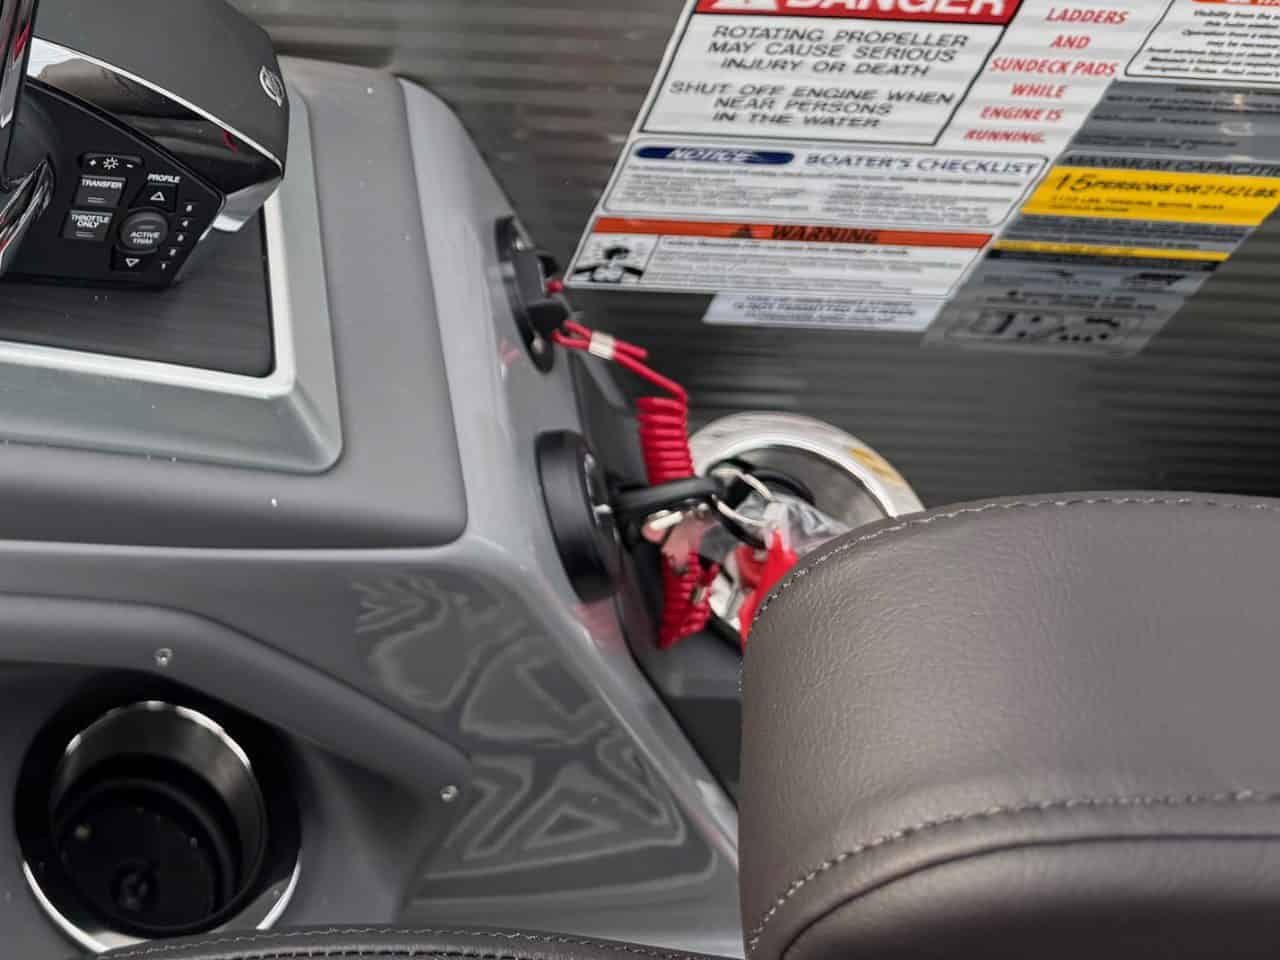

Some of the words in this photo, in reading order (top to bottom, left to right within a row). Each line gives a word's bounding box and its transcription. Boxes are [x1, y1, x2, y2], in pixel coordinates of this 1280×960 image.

[1045, 8, 1129, 25] LADDERS
[712, 25, 825, 42] ROTATING
[833, 29, 969, 48] PROPELLER
[1050, 35, 1091, 49] AND
[708, 42, 755, 54] MAY
[765, 42, 844, 58] CAUSE
[853, 46, 958, 62] SERIOUS
[720, 58, 802, 72] INJURY
[811, 60, 846, 73] OR
[853, 61, 931, 77] DEATH
[990, 57, 1070, 75] SUNDECK
[1072, 60, 1119, 77] PADS
[670, 81, 732, 95] SHUT
[739, 83, 784, 96] OFF
[792, 86, 879, 101] ENGINE
[887, 91, 956, 105] WHEN
[1011, 83, 1067, 98] WHILE
[713, 96, 775, 110] NEAR
[784, 98, 893, 116] PERSONS
[980, 106, 1042, 120] ENGINE
[1045, 108, 1064, 121] IS
[712, 112, 736, 122] IN
[749, 112, 793, 124] THE
[803, 115, 880, 128] WATER
[667, 147, 754, 162] NOTICE
[804, 152, 911, 169] BOATER'S
[917, 157, 1040, 175] CHECKLIST
[81, 178, 122, 189] TRANSFER
[147, 173, 181, 183] PROFILE
[71, 213, 111, 224] THROTTLE
[77, 220, 100, 229] ONLY
[129, 231, 160, 240] ACTIVE
[771, 225, 880, 244] WARNING
